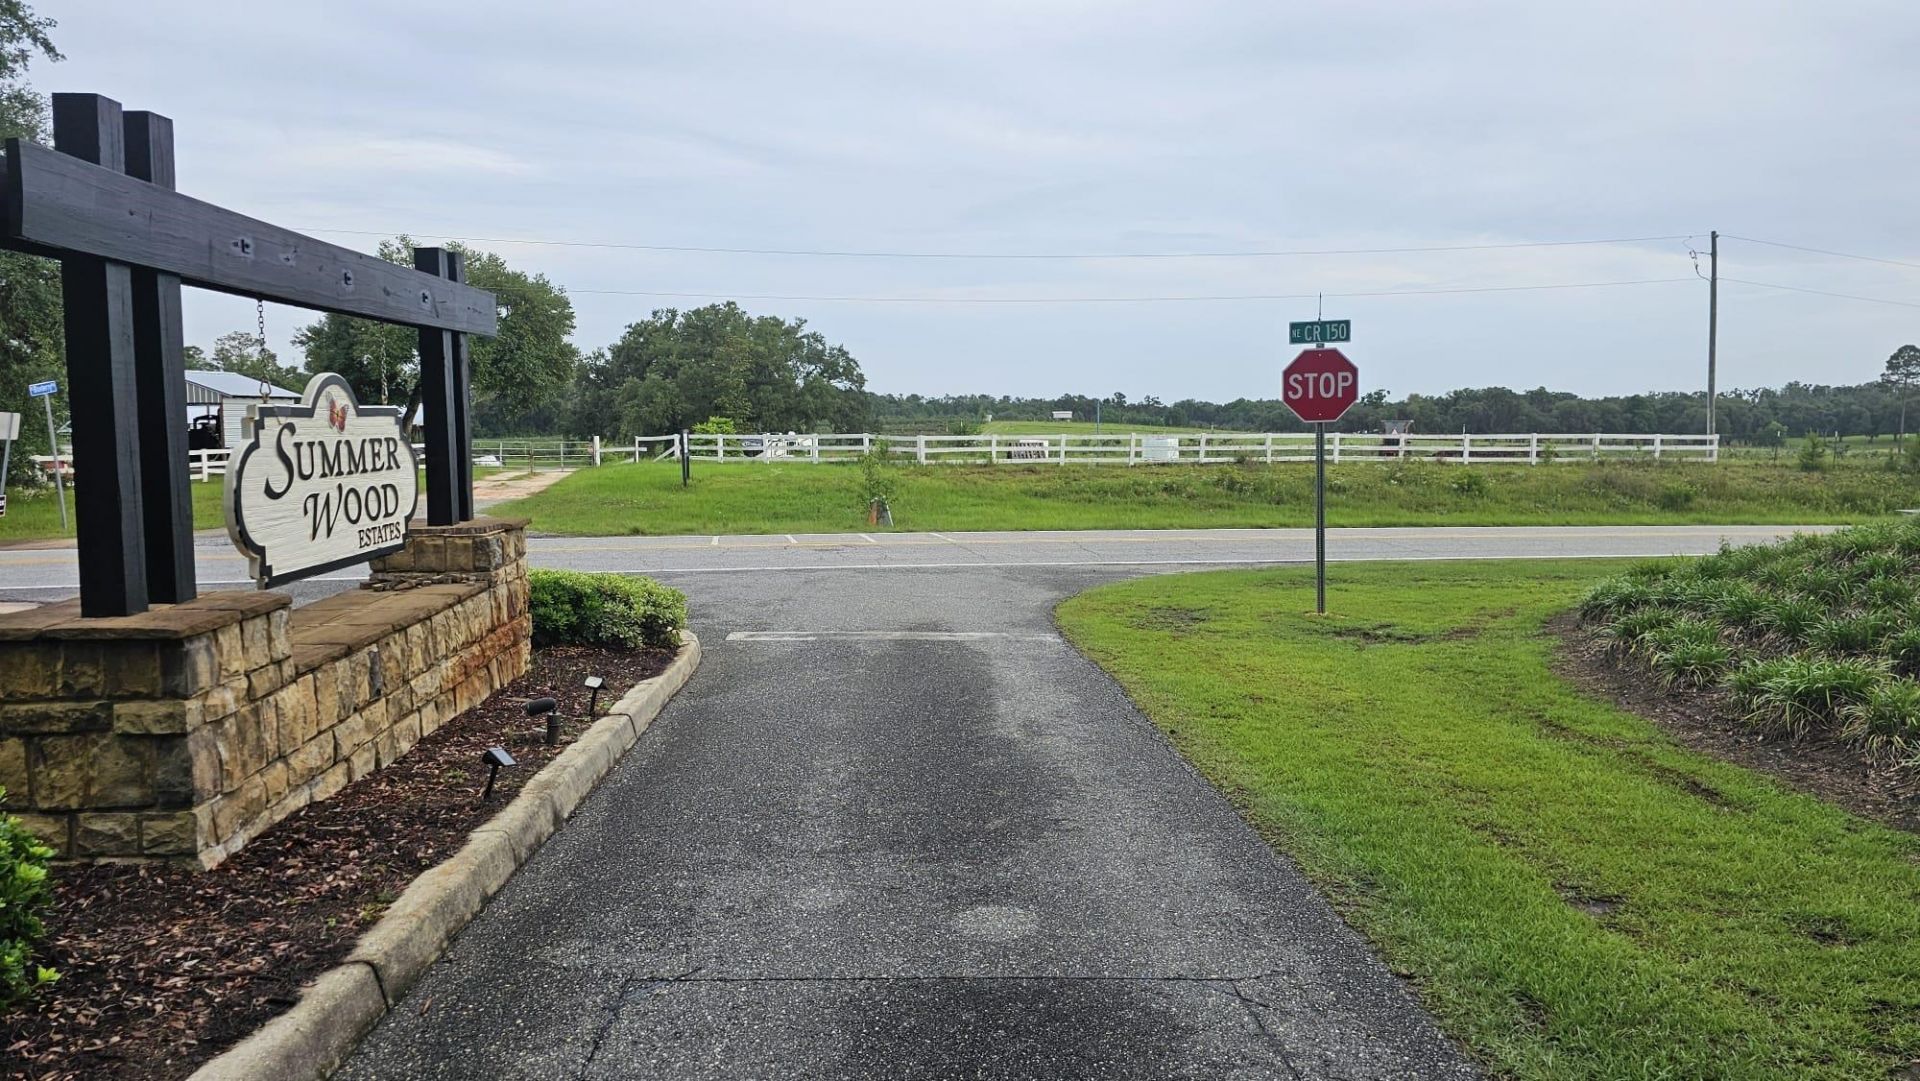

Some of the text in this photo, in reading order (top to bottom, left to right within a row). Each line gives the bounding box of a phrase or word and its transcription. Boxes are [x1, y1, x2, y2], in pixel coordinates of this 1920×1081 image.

[1292, 323, 1347, 341] NE CR 150
[1287, 371, 1353, 400] STOP
[264, 422, 401, 500] SUMMER
[303, 483, 399, 542] WOOD
[358, 521, 401, 549] ESTATES
